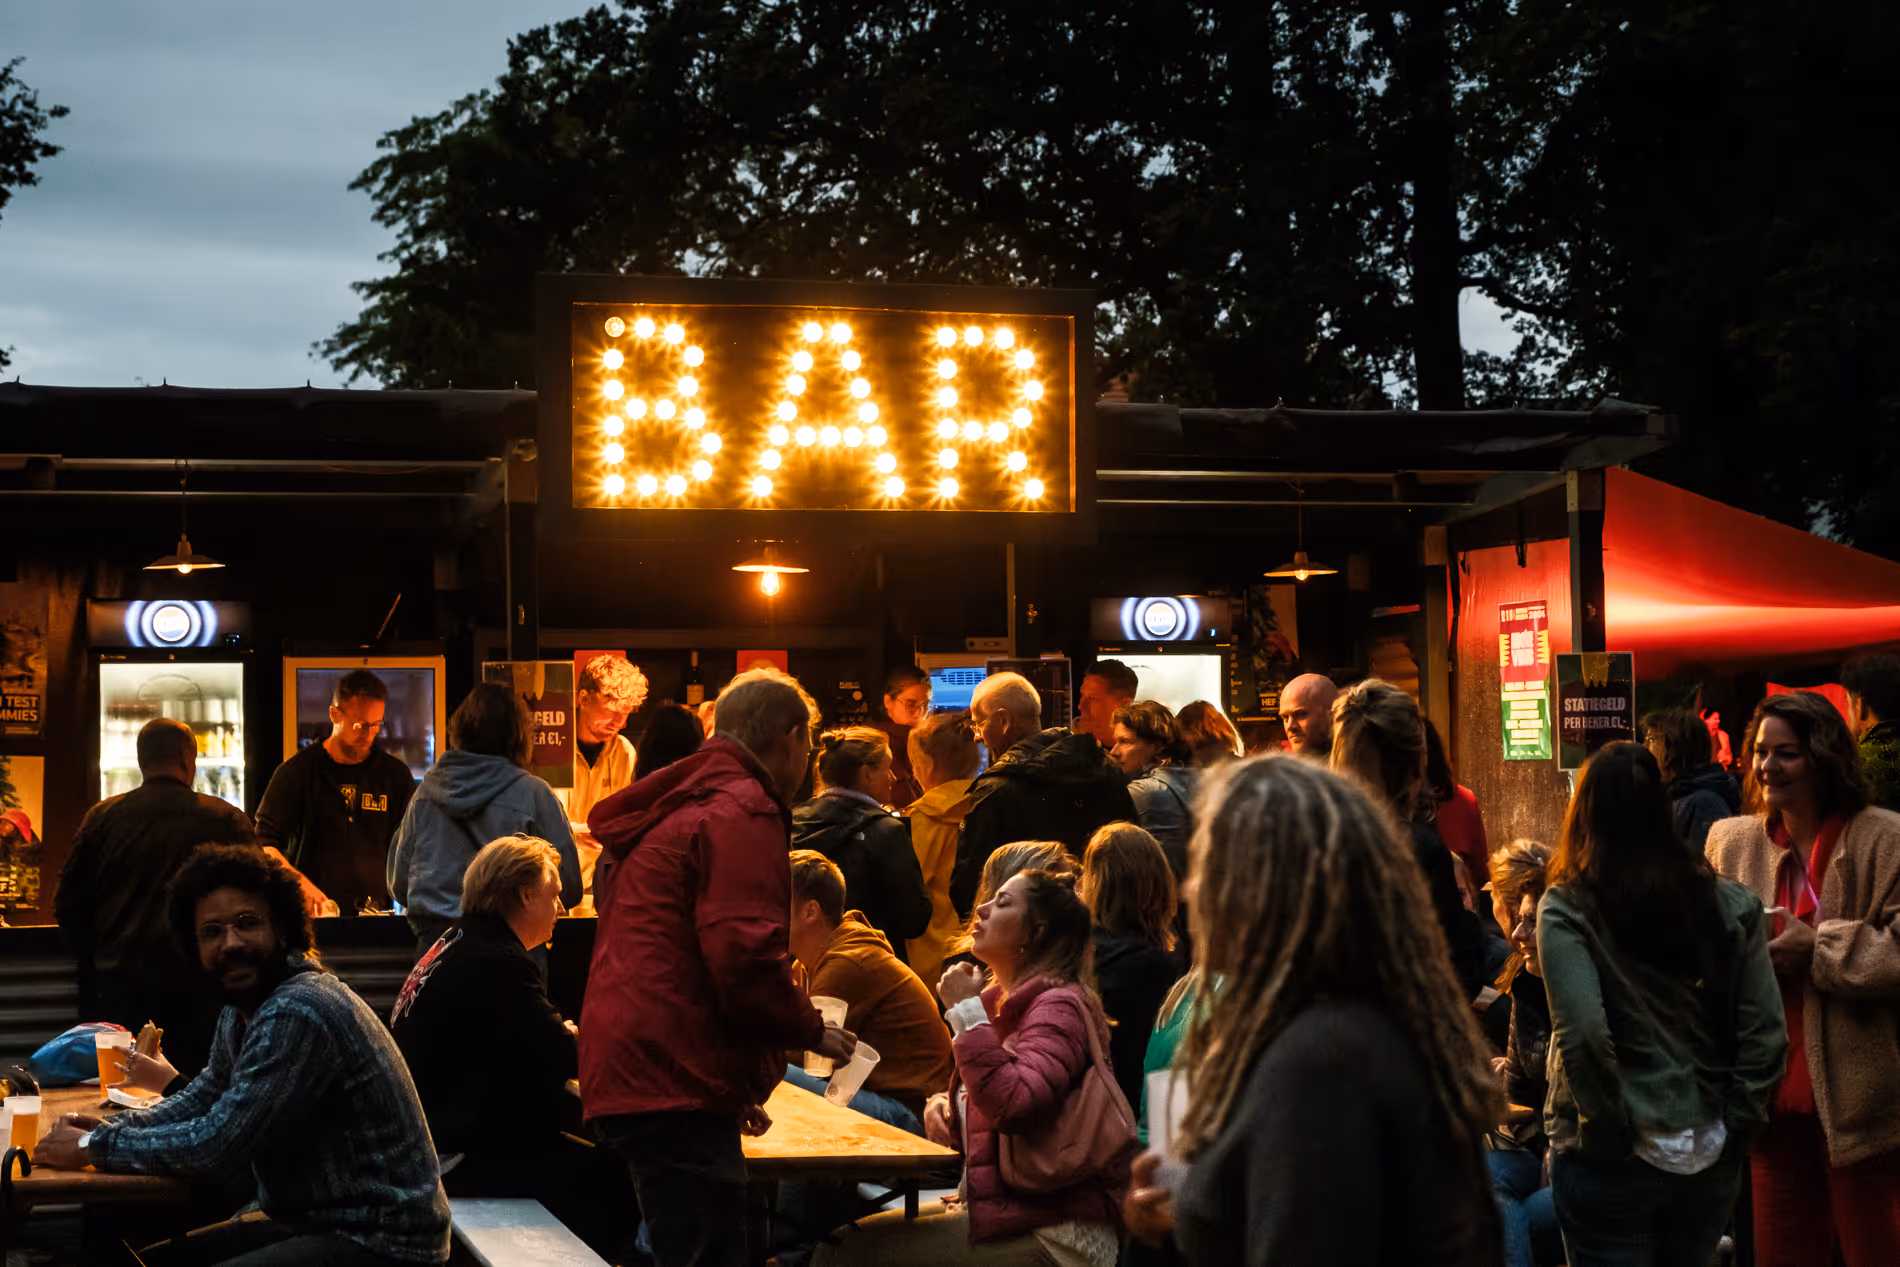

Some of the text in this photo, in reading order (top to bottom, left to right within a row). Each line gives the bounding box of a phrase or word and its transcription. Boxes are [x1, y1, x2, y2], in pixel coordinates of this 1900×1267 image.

[602, 315, 1046, 500] BAR
[5, 695, 39, 708] TEST
[1564, 697, 1626, 712] STATIEGELD
[533, 711, 566, 726] GELD
[1564, 716, 1581, 729] PER
[547, 731, 566, 746] €1,-
